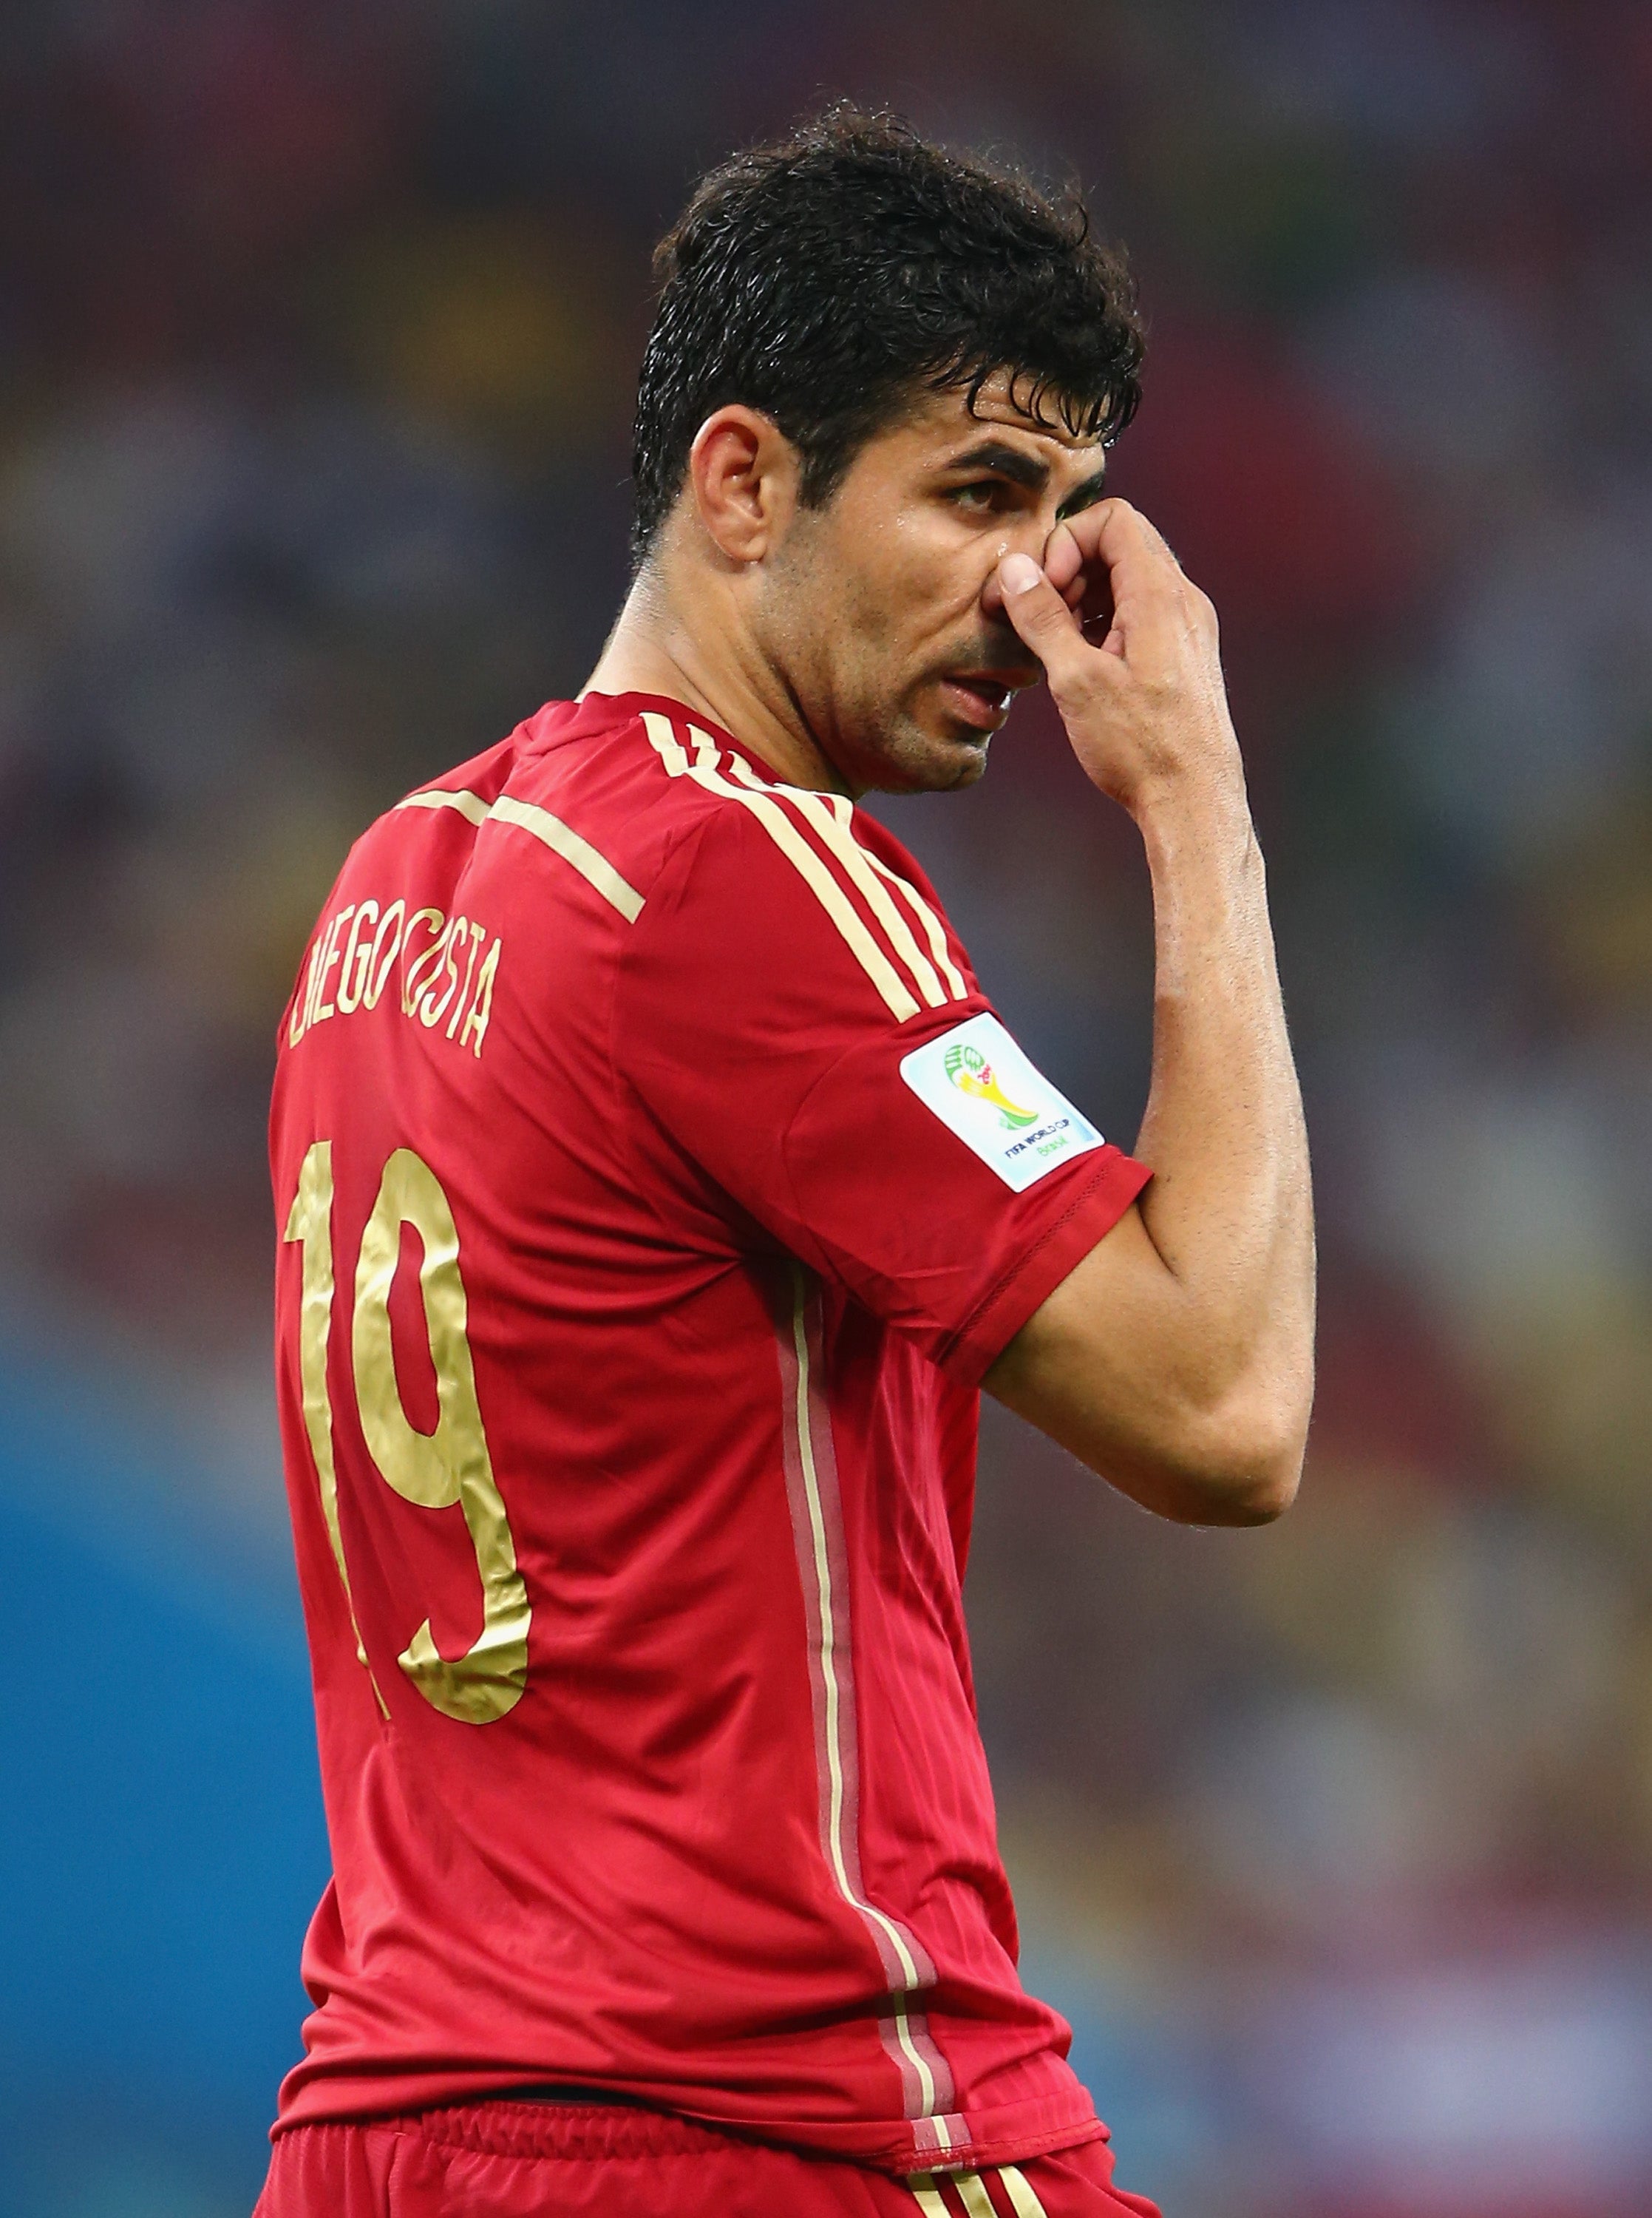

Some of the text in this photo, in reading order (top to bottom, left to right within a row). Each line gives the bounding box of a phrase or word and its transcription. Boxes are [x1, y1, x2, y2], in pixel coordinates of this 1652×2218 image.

[401, 906, 502, 1059] COSTA
[1005, 1119, 1070, 1159] FIFA WORLD CUP
[284, 1141, 532, 1725] 19
